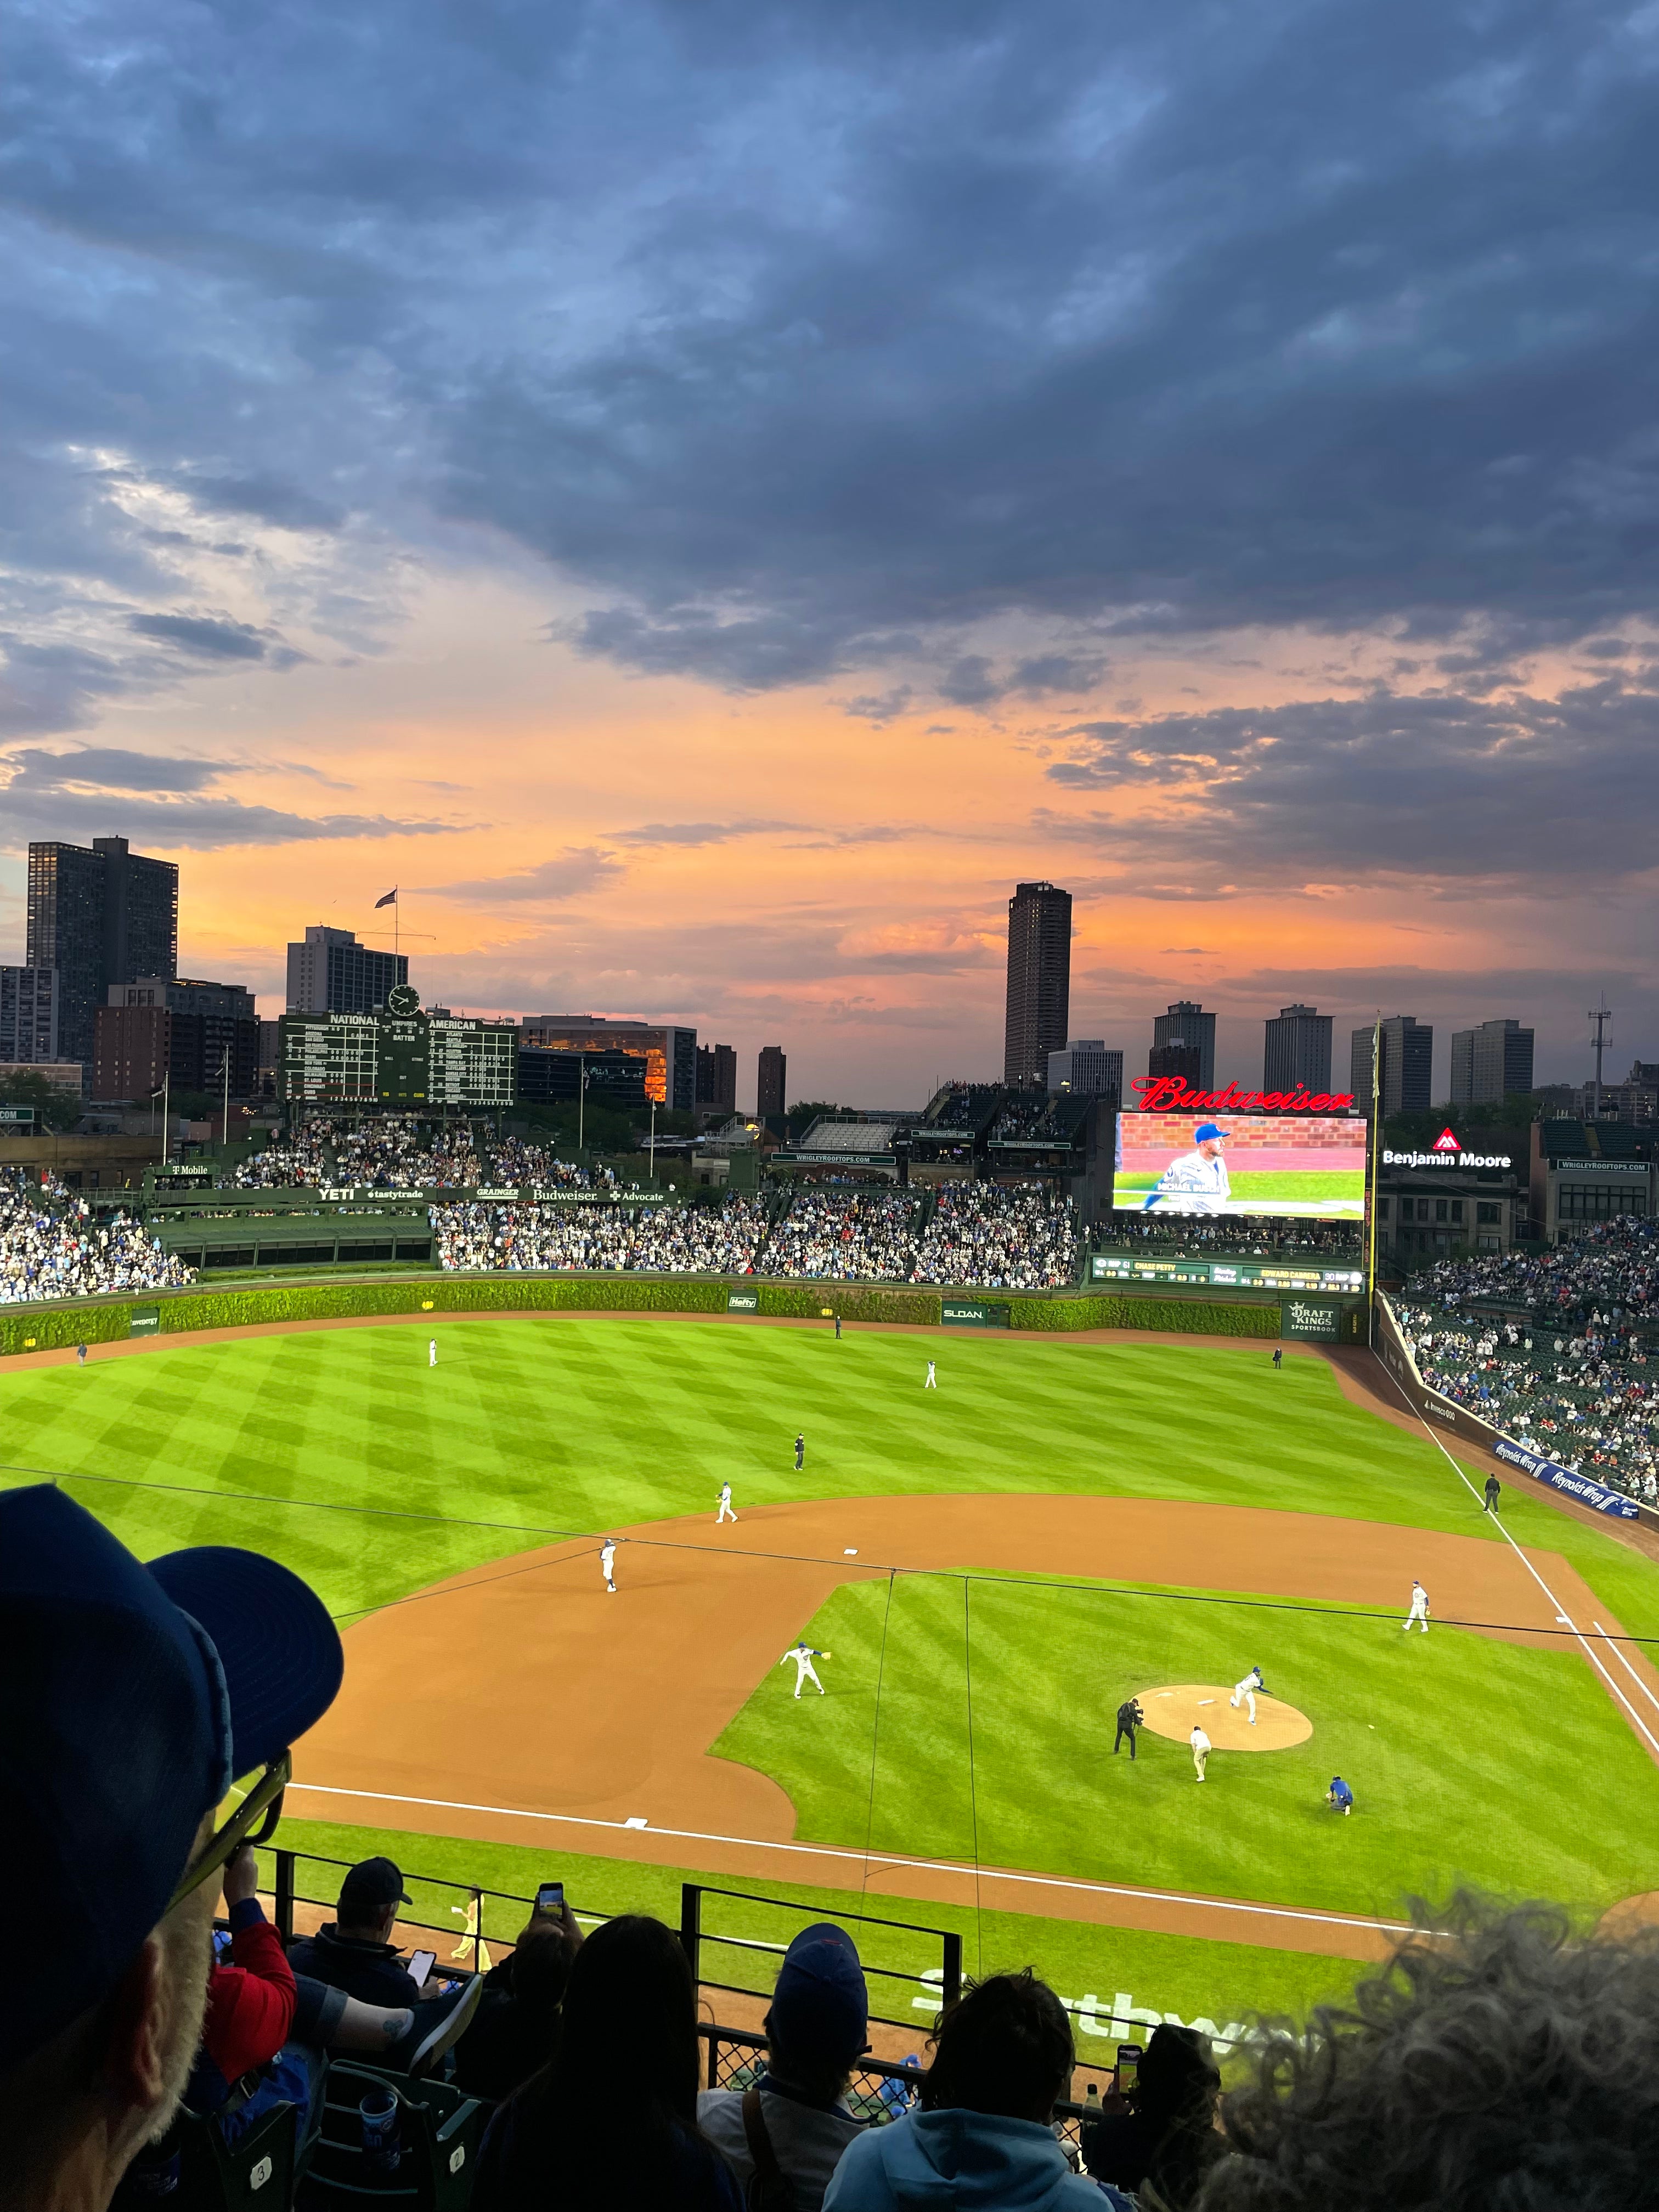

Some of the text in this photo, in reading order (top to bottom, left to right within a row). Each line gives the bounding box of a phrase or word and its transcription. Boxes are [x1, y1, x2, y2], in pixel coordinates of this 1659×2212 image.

[331, 1015, 380, 1025] NATIONAL
[429, 1019, 476, 1030] AMERICAN
[1131, 1076, 1356, 1111] Budweiser
[796, 1154, 870, 1163] WRIGLEYROOFTOPS.COM
[1383, 1150, 1512, 1167] Benjamin Moore
[181, 1165, 208, 1175] Mobile
[1562, 1161, 1646, 1171] WRIGLEYROOFTOPS.COM
[1158, 1182, 1192, 1192] MICHAEL
[319, 1188, 355, 1200] YETI
[374, 1190, 424, 1199] tastytrade
[622, 1192, 664, 1201] Advocate
[1123, 1261, 1130, 1269] 61
[1135, 1262, 1176, 1271] CHASE PETTY
[1261, 1269, 1321, 1280] EDWARD CABRERA
[1324, 1273, 1335, 1281] 30
[731, 1297, 755, 1306] Hefty
[1291, 1308, 1334, 1318] DRAFT
[1296, 1316, 1332, 1325] KINGS
[1291, 1324, 1336, 1333] SPORTSBOOK
[1431, 1402, 1446, 1417] Invesco
[1446, 1408, 1455, 1421] QQQ
[1496, 1443, 1537, 1474] Reynolds Wrap
[1551, 1471, 1605, 1505] Reynolds Wrap
[454, 2152, 460, 2168] 2
[257, 2165, 264, 2181] 3
